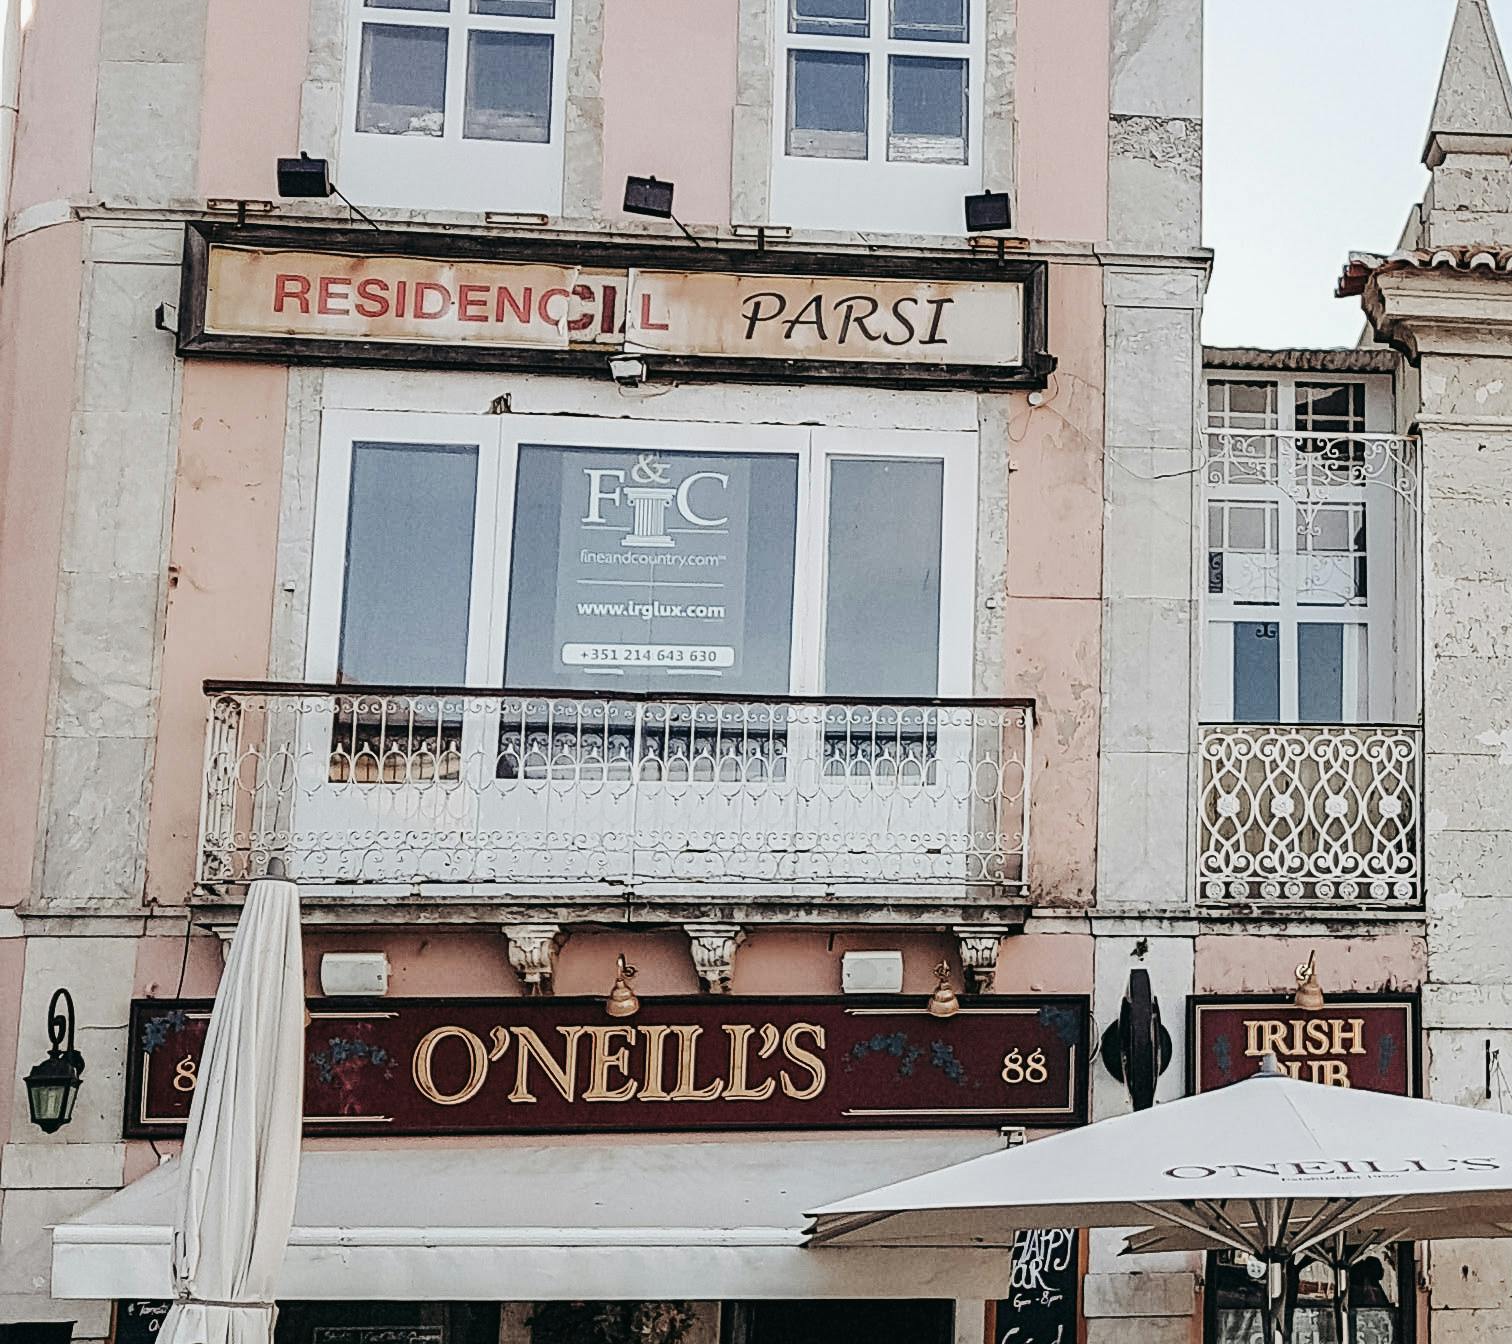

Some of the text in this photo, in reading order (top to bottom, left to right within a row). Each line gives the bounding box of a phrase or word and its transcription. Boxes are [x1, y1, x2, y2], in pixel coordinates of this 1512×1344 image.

[742, 292, 954, 345] PARSI
[581, 648, 717, 662] +351 214 643 630
[1243, 1018, 1367, 1055] IRISH
[412, 1022, 827, 1105] O'NEILL'S
[1002, 1047, 1047, 1083] 88
[1259, 1059, 1351, 1089] UB
[1163, 1157, 1501, 1180] O'NEILL'S
